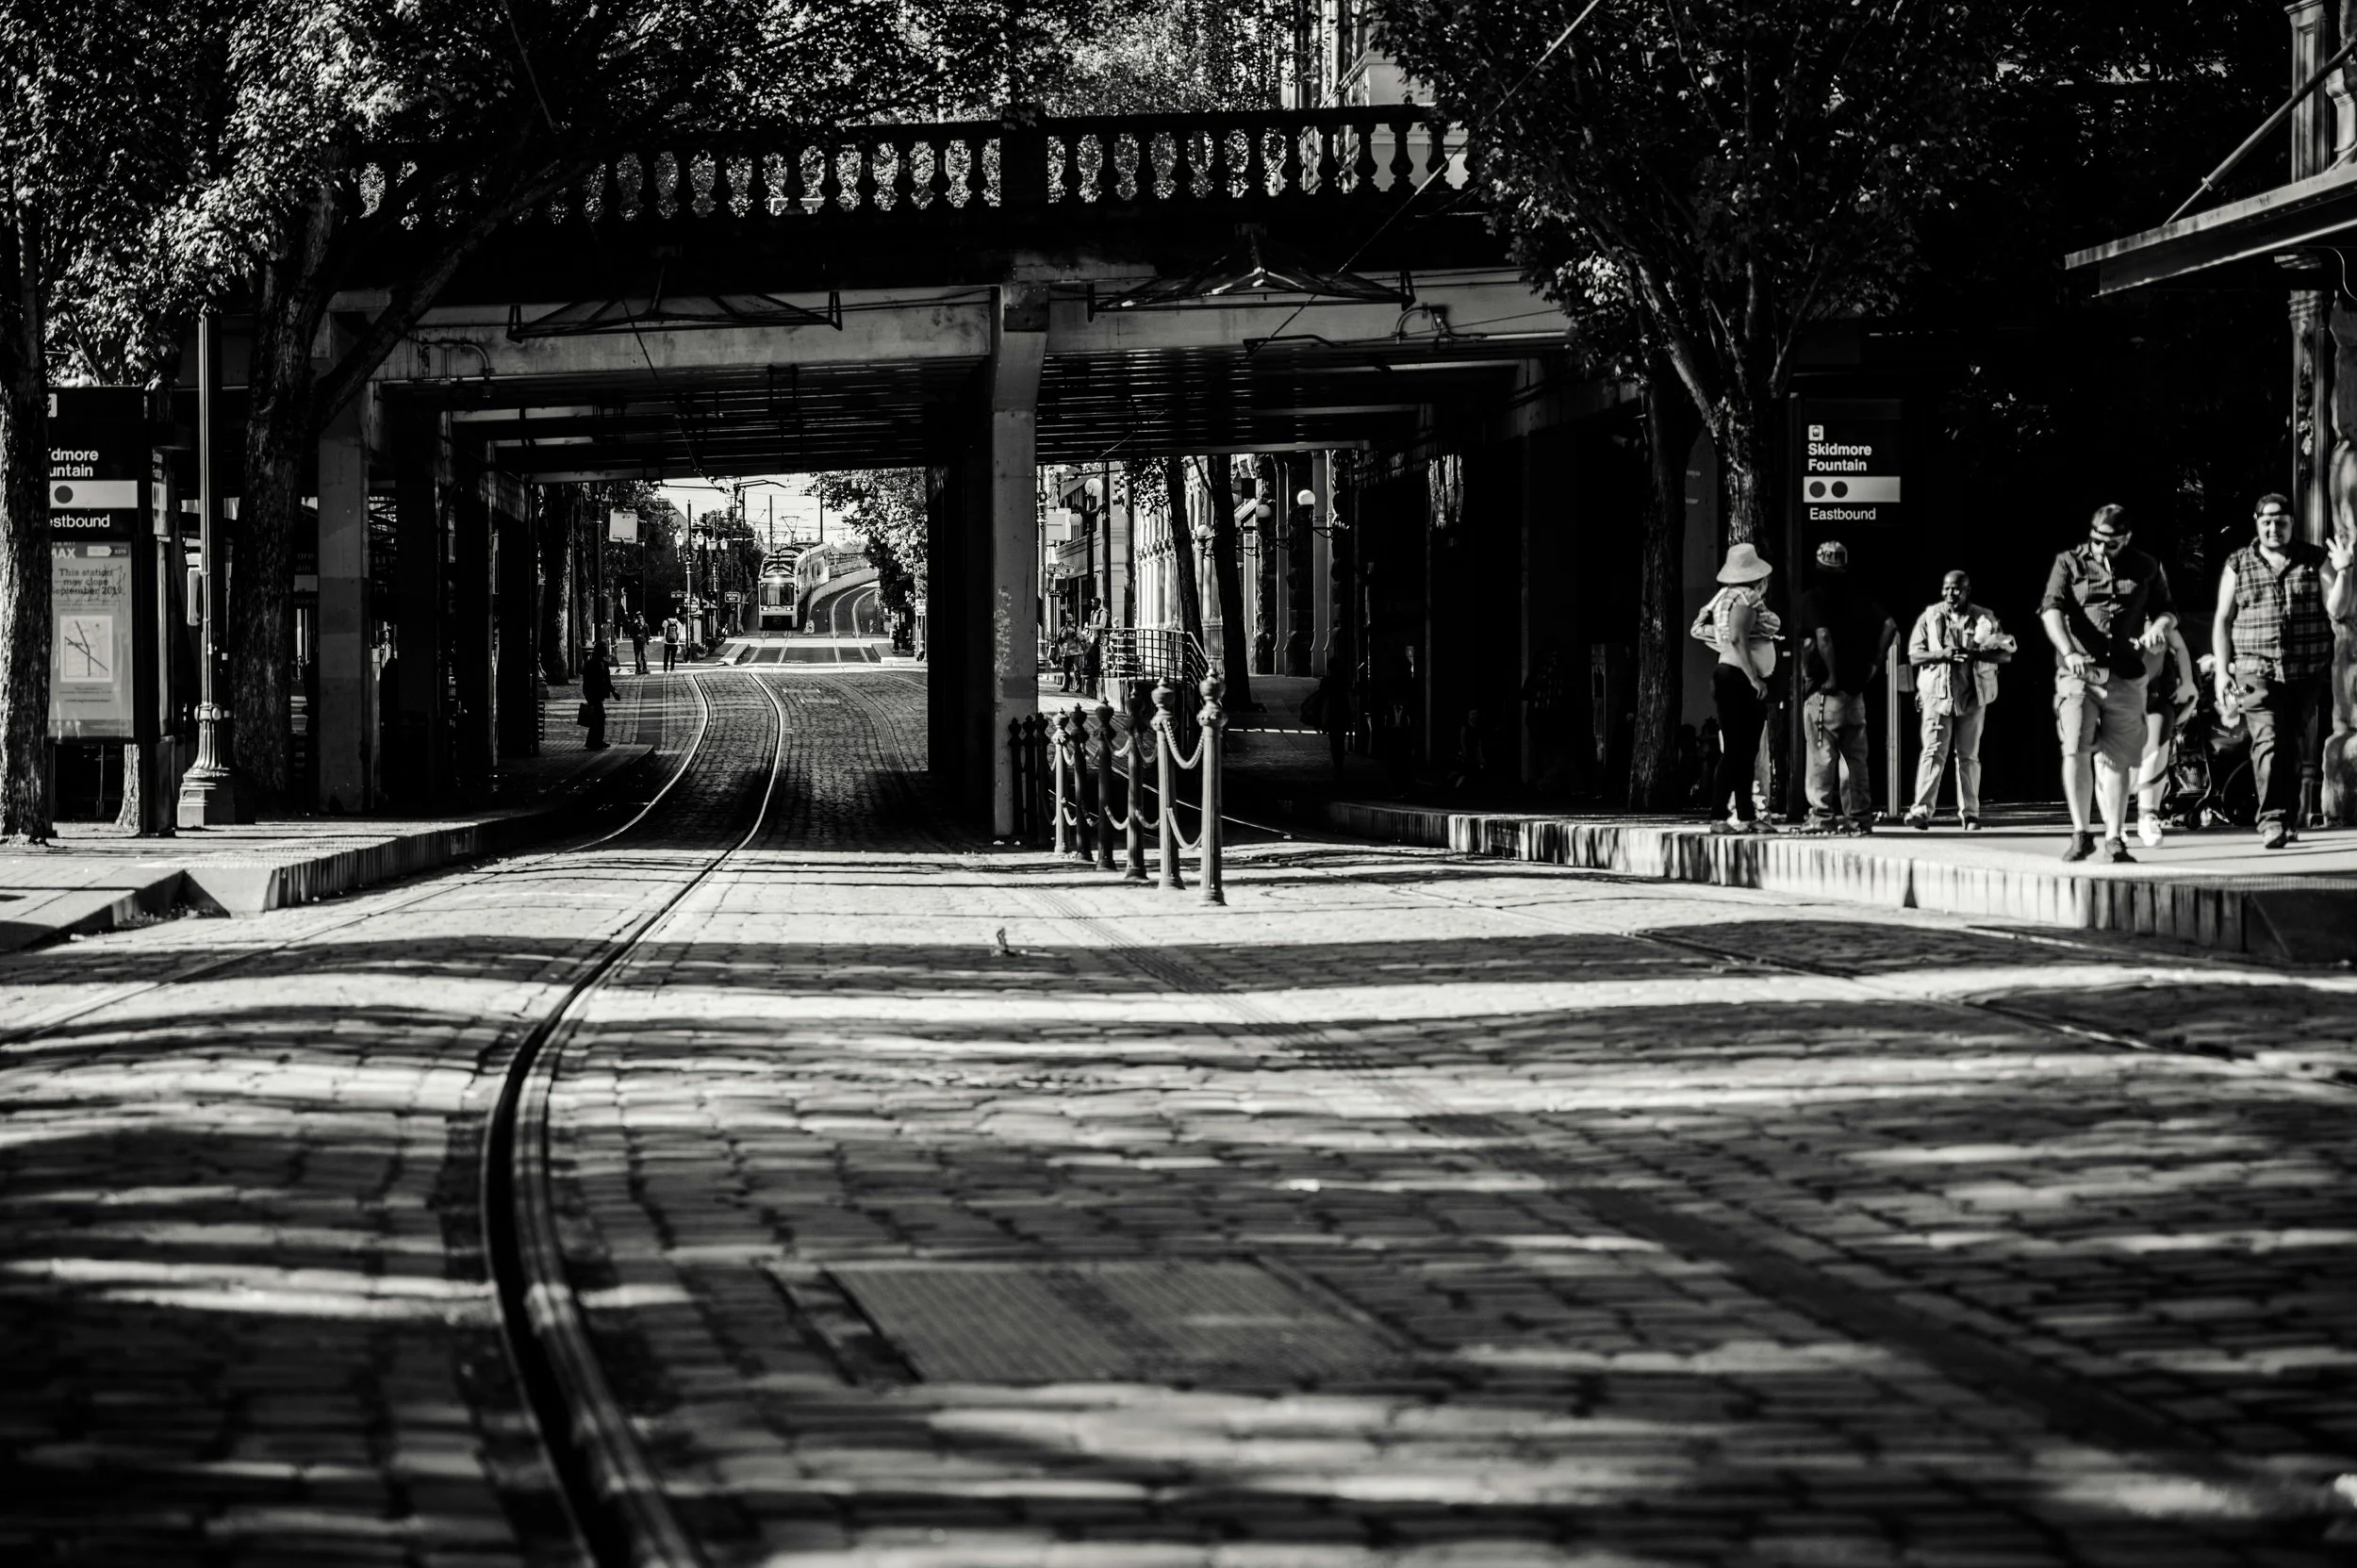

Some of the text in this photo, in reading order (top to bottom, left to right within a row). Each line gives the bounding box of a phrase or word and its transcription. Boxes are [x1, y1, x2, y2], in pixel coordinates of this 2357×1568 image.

[48, 448, 99, 462] dmore
[1807, 442, 1872, 455] Skidmore
[49, 464, 93, 477] untain
[1807, 458, 1868, 471] Fountain
[1809, 507, 1876, 520] Eastbound
[49, 513, 110, 528] stbound
[58, 568, 113, 576] This station
[63, 577, 108, 586] may close
